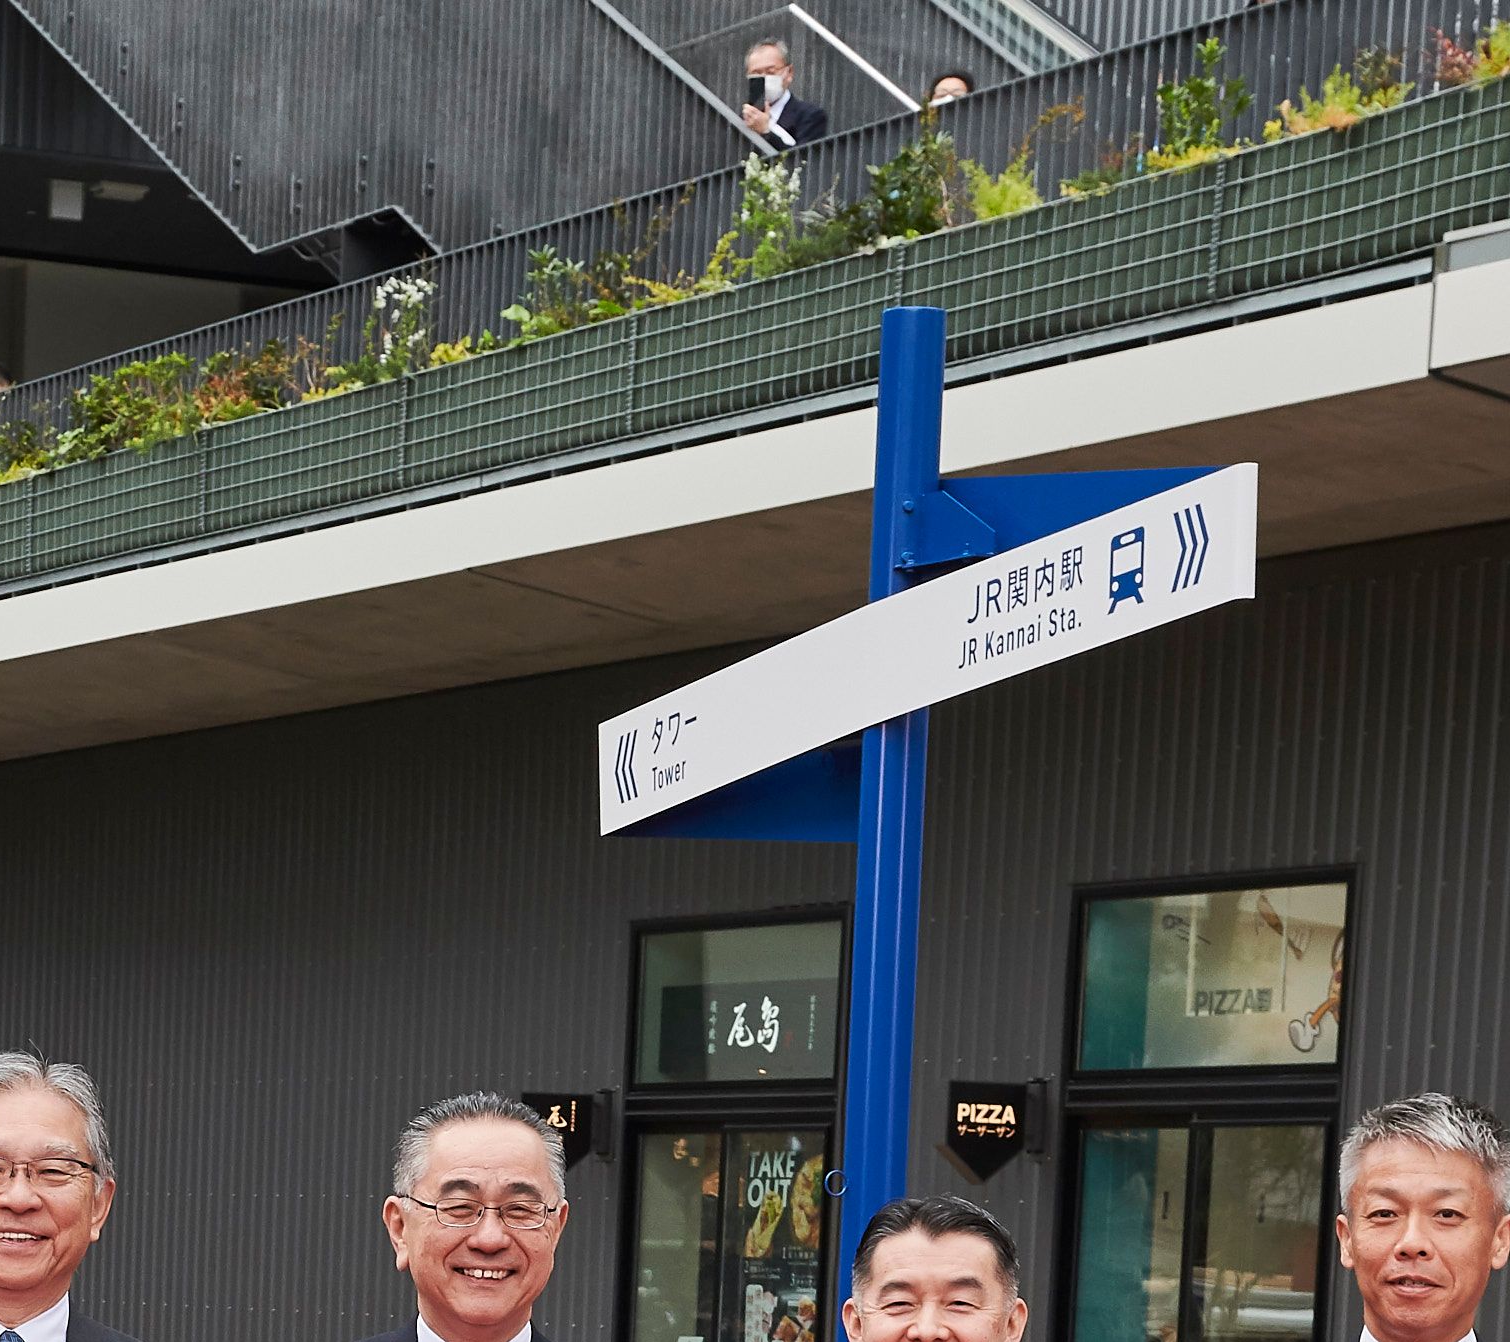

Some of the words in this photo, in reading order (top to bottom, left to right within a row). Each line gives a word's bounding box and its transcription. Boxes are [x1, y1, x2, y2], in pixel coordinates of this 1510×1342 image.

[967, 545, 1083, 624] JR関内駅
[958, 637, 977, 669] JR
[985, 613, 1041, 660] Kannai
[1048, 607, 1082, 637] Sta.
[651, 712, 697, 755] タワー
[651, 760, 686, 791] Tower
[957, 1103, 1015, 1125] PIZZA
[749, 1151, 797, 1178] TAKE
[747, 1178, 791, 1208] OUT
